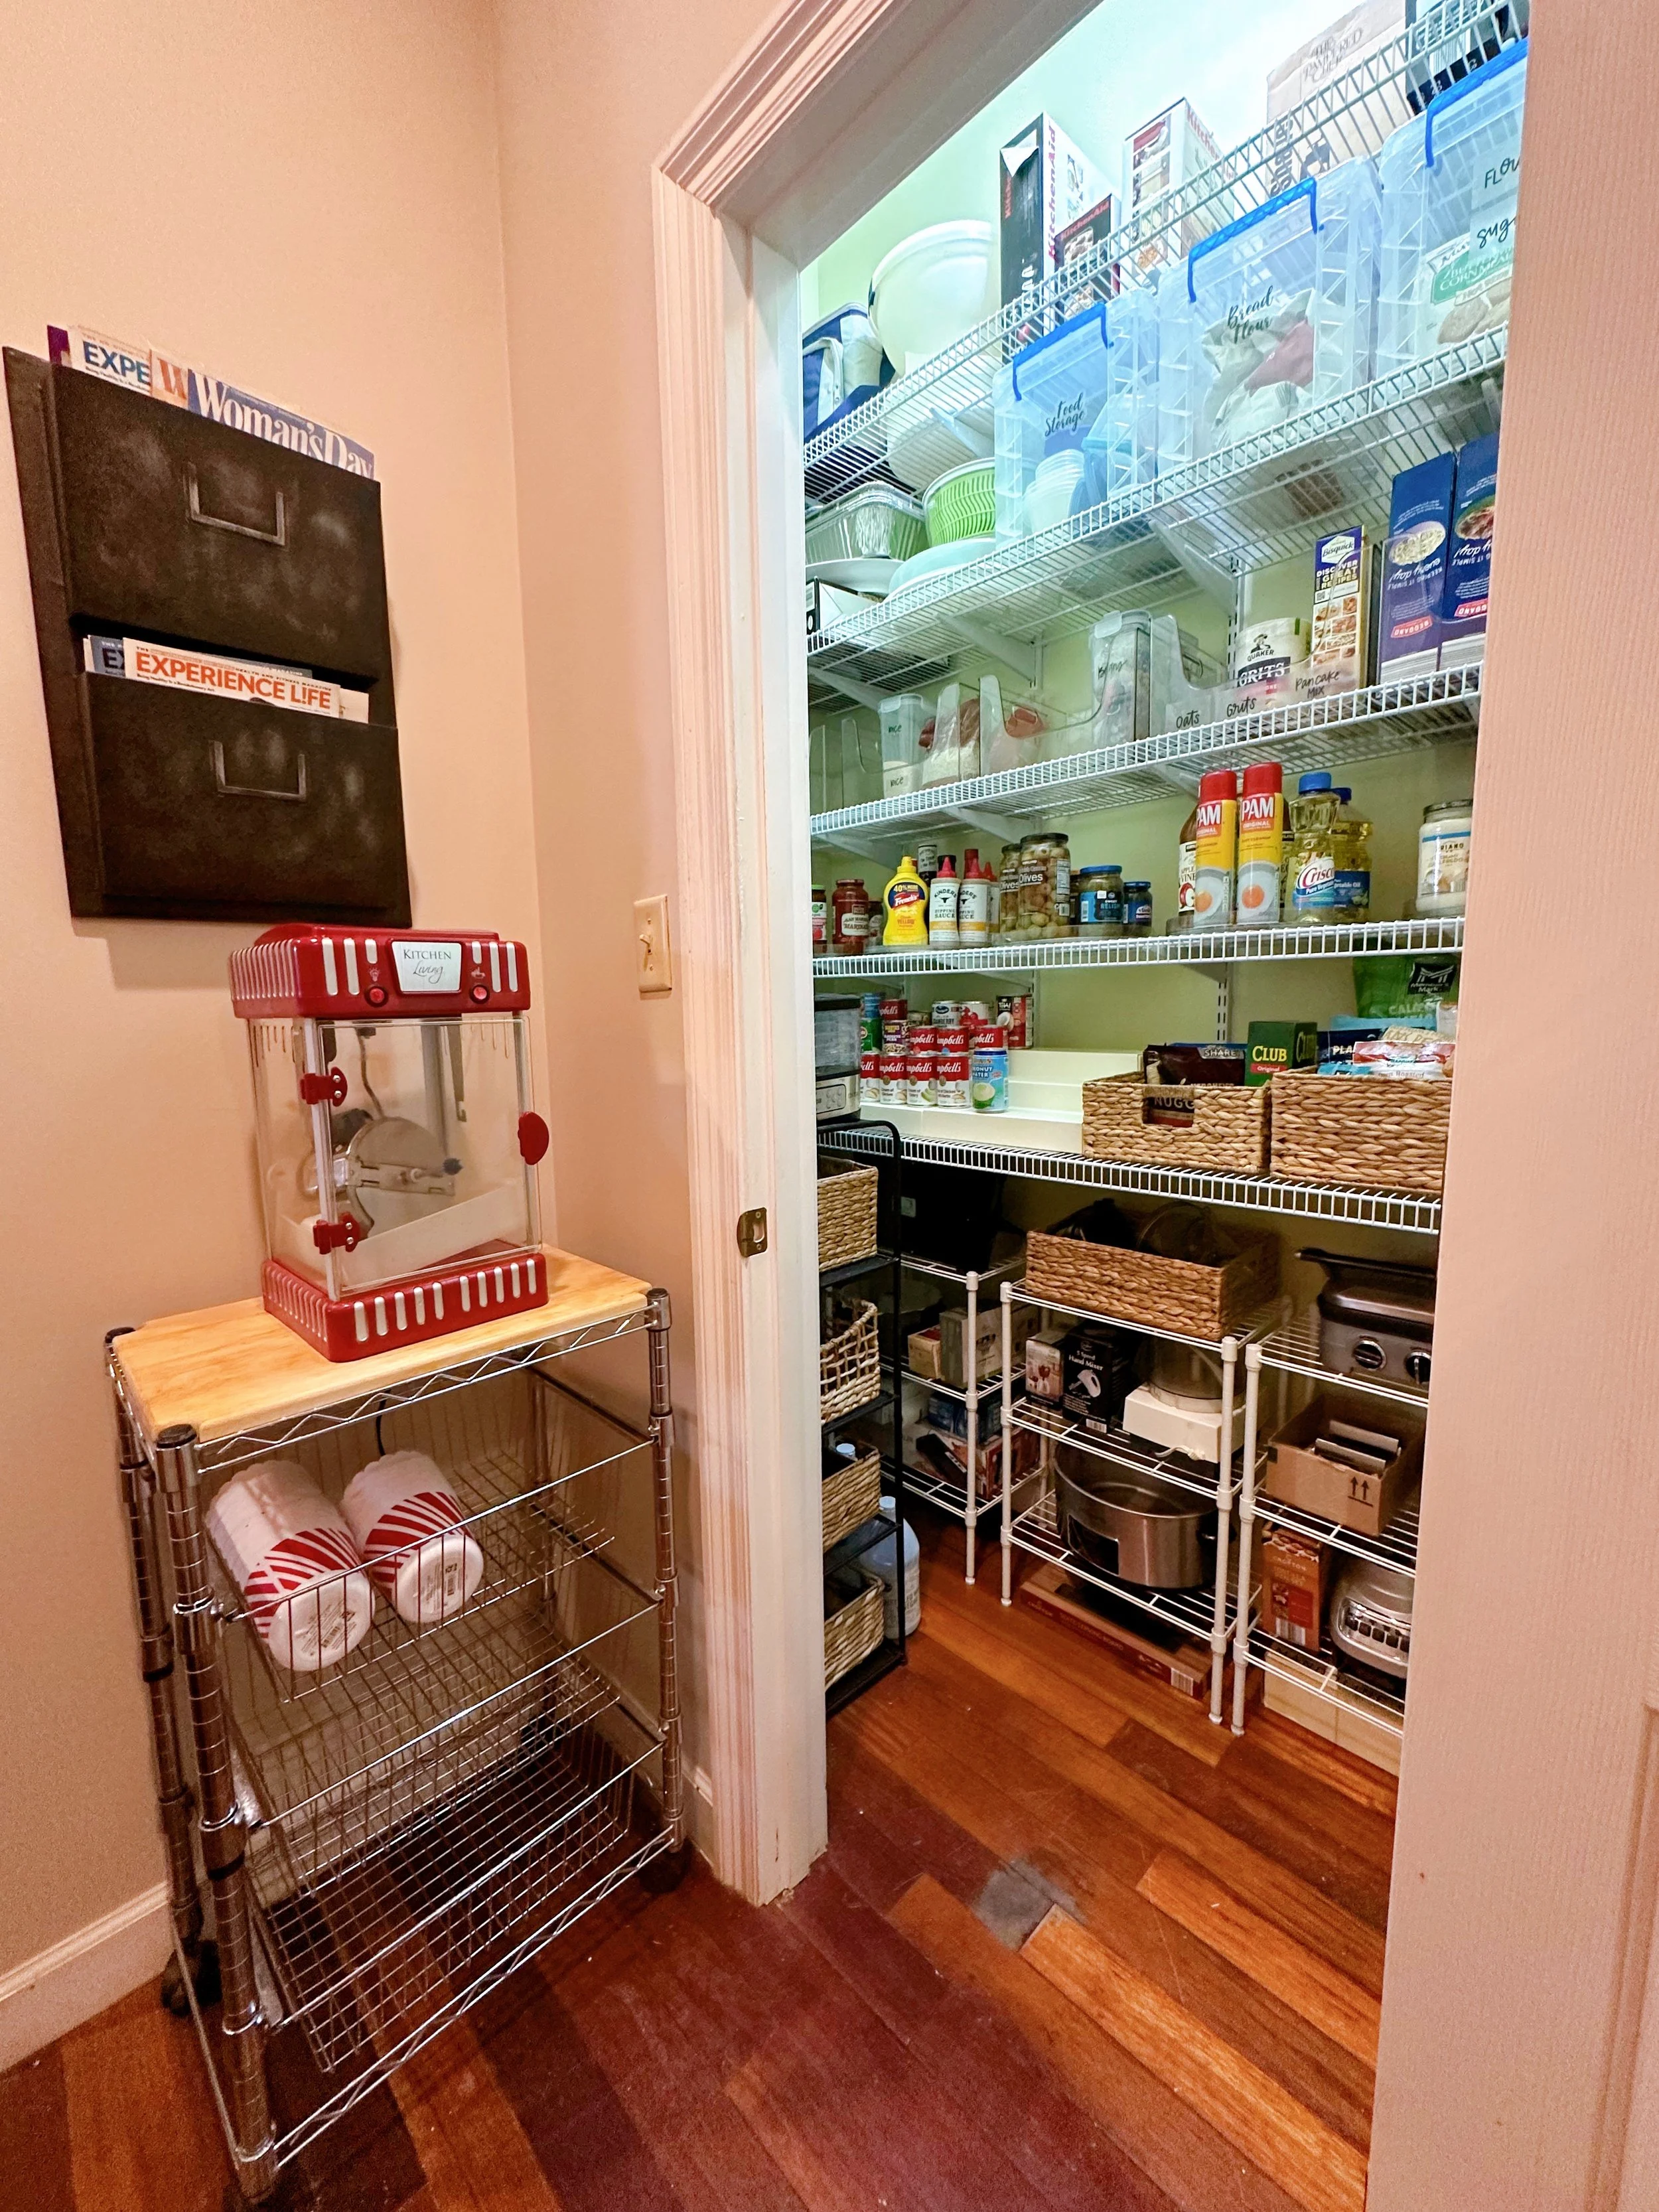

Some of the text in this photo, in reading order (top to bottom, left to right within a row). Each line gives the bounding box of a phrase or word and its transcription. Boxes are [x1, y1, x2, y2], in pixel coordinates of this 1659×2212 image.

[1227, 285, 1273, 329] Bread
[193, 372, 374, 479] Woman's Day
[1045, 410, 1085, 437] Storage
[1323, 542, 1354, 557] Bisquick
[1247, 648, 1275, 662] QUAKER
[136, 652, 285, 700] EXPERIENCE
[1238, 662, 1285, 688] GRITS
[1226, 696, 1258, 718] Grits
[1242, 796, 1274, 822] PAM
[1019, 873, 1044, 883] Olives
[403, 949, 452, 960] KITCHEN
[413, 960, 443, 984] Living
[1252, 1045, 1287, 1062] CLUB
[1068, 1355, 1104, 1371] Hand Mixer
